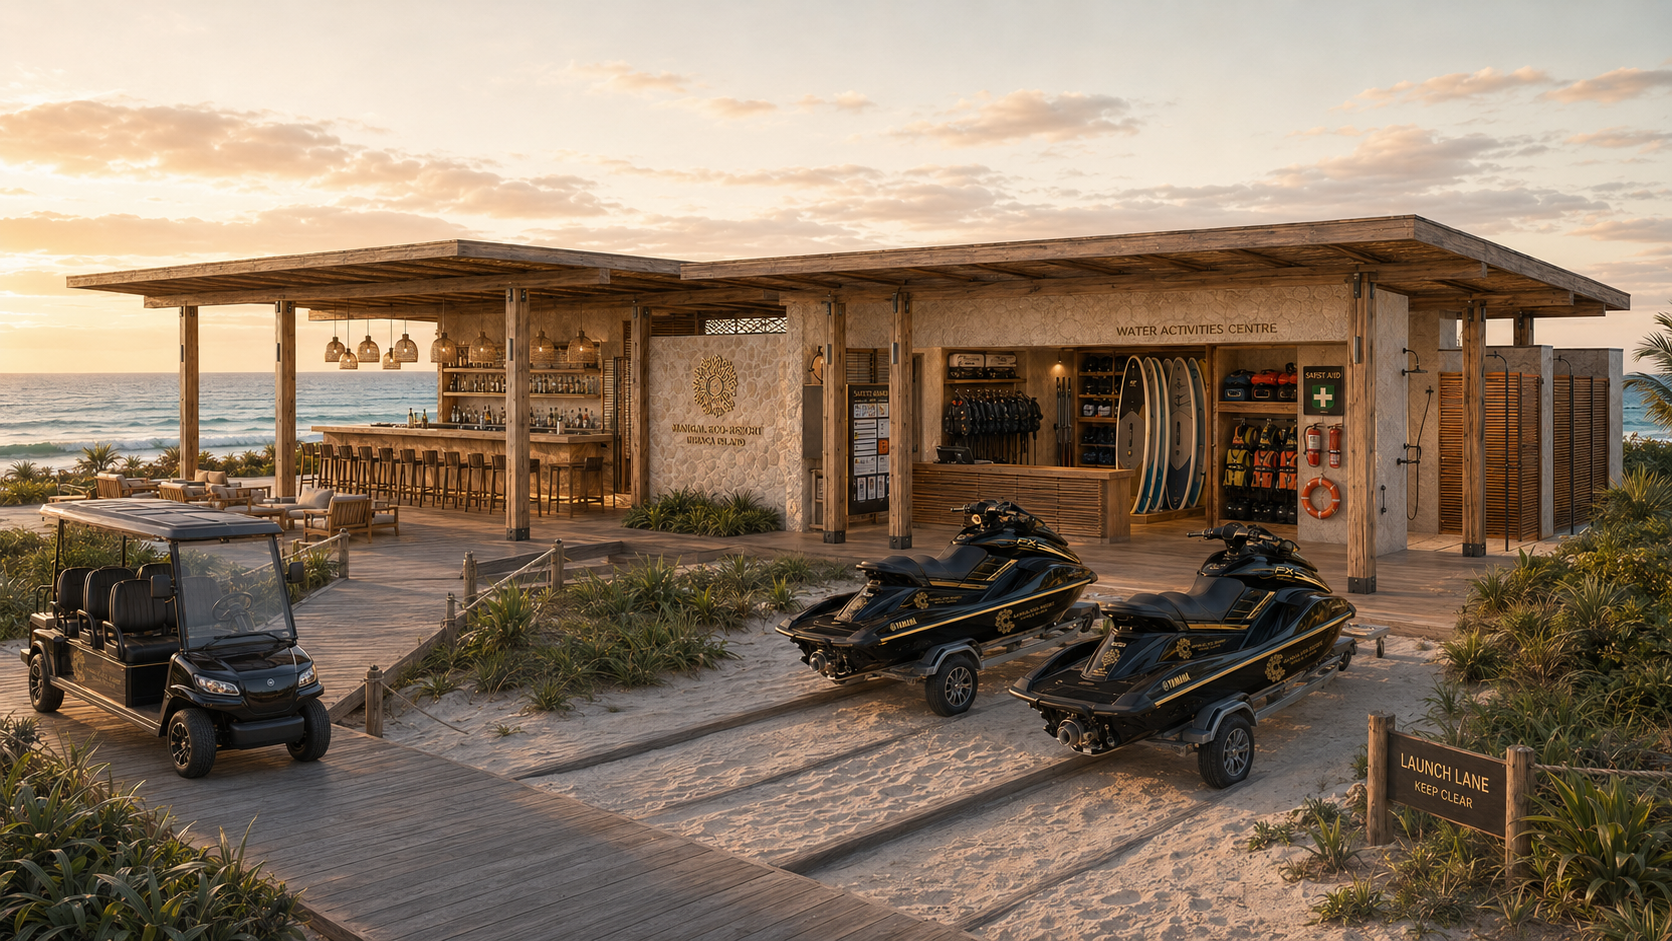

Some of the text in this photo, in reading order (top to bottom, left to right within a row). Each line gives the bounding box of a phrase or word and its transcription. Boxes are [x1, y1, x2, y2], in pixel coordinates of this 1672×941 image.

[1116, 323, 1278, 336] WATER ACTIVITIES CENTRE
[1275, 566, 1294, 575] FX
[1401, 752, 1490, 794] LAUNCH LANE
[1414, 780, 1473, 809] KEEP CLEAR
